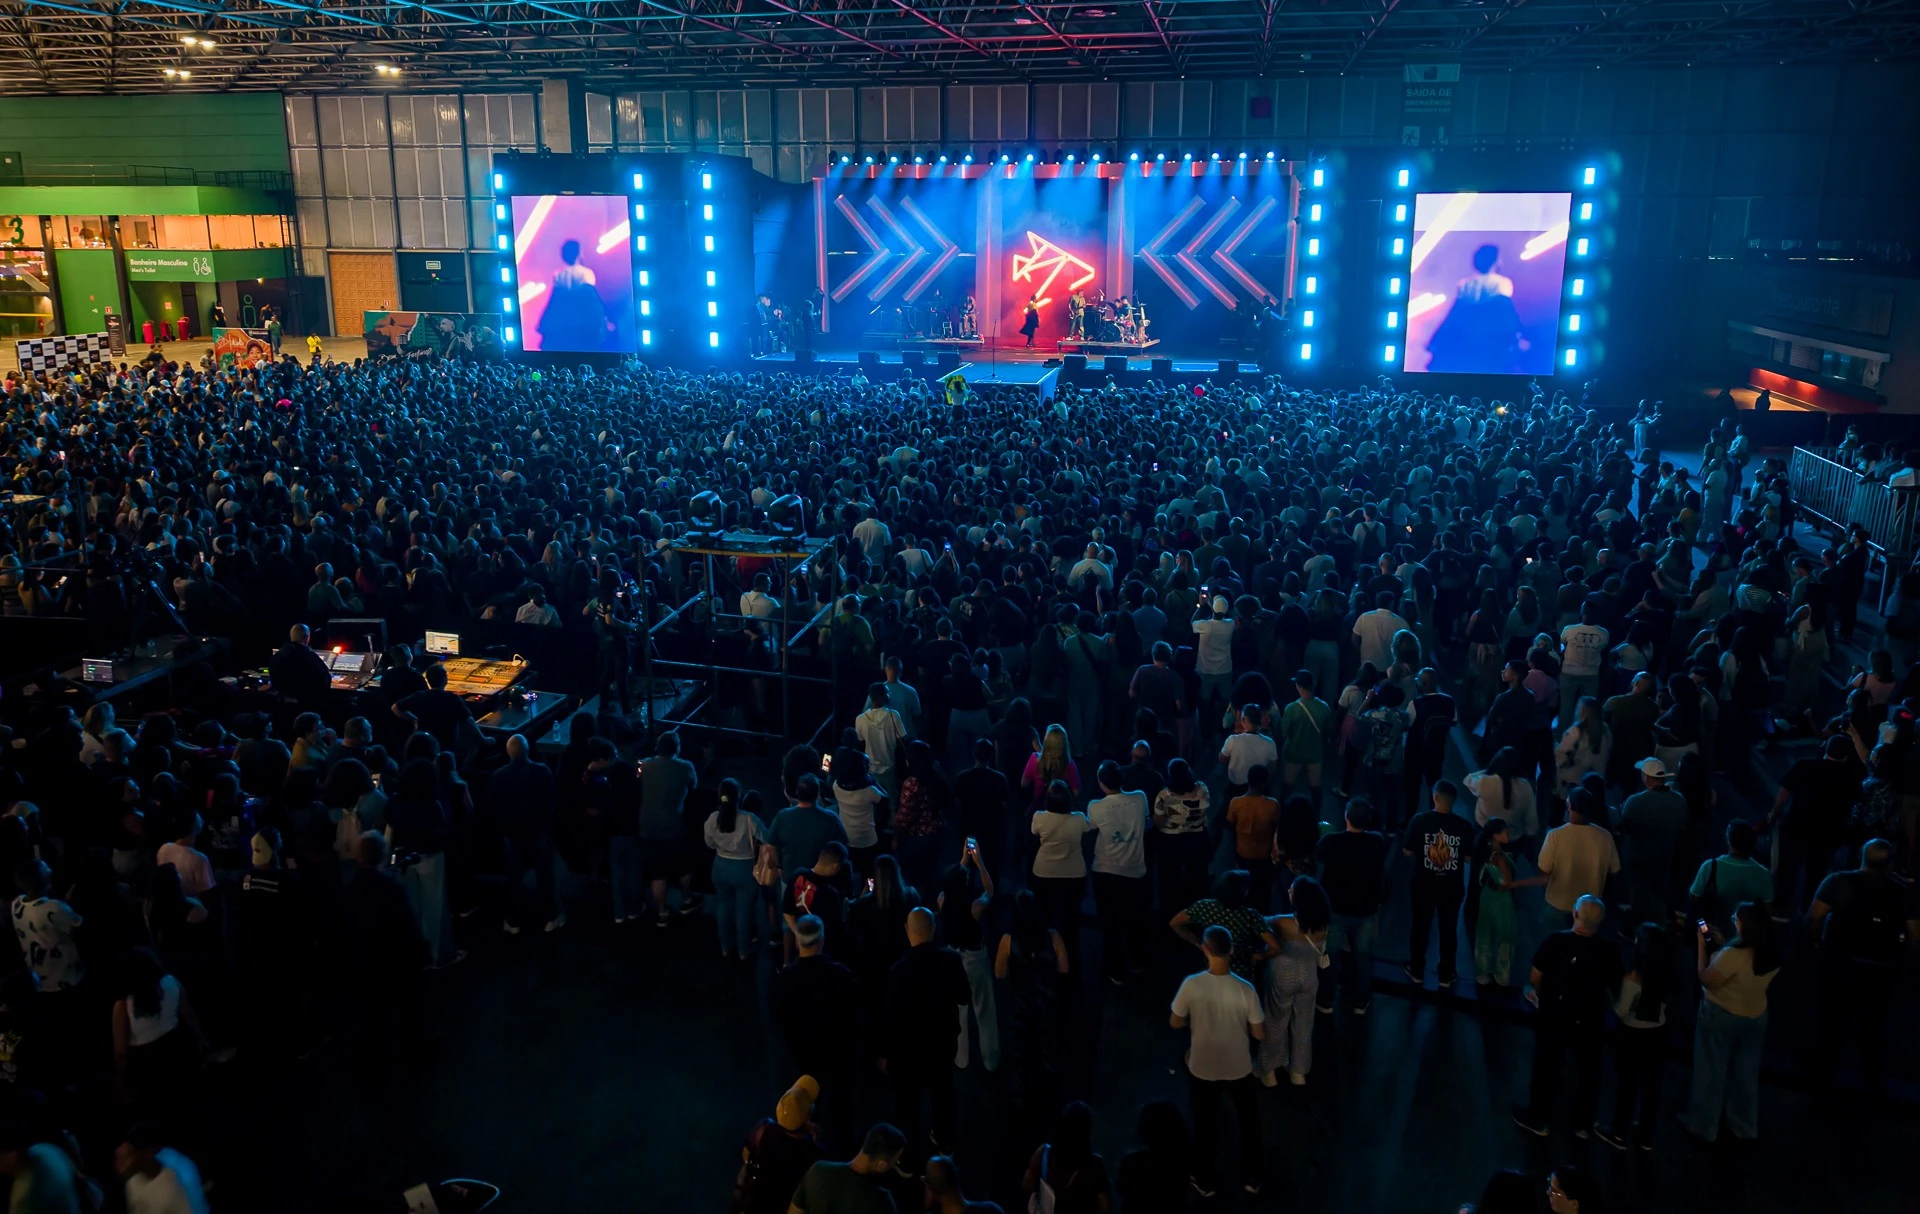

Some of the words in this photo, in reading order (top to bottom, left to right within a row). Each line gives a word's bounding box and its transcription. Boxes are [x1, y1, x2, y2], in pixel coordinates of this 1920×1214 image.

[1438, 88, 1452, 97] DE
[9, 217, 24, 244] 3
[130, 258, 157, 266] Banheiro
[1424, 833, 1431, 844] E
